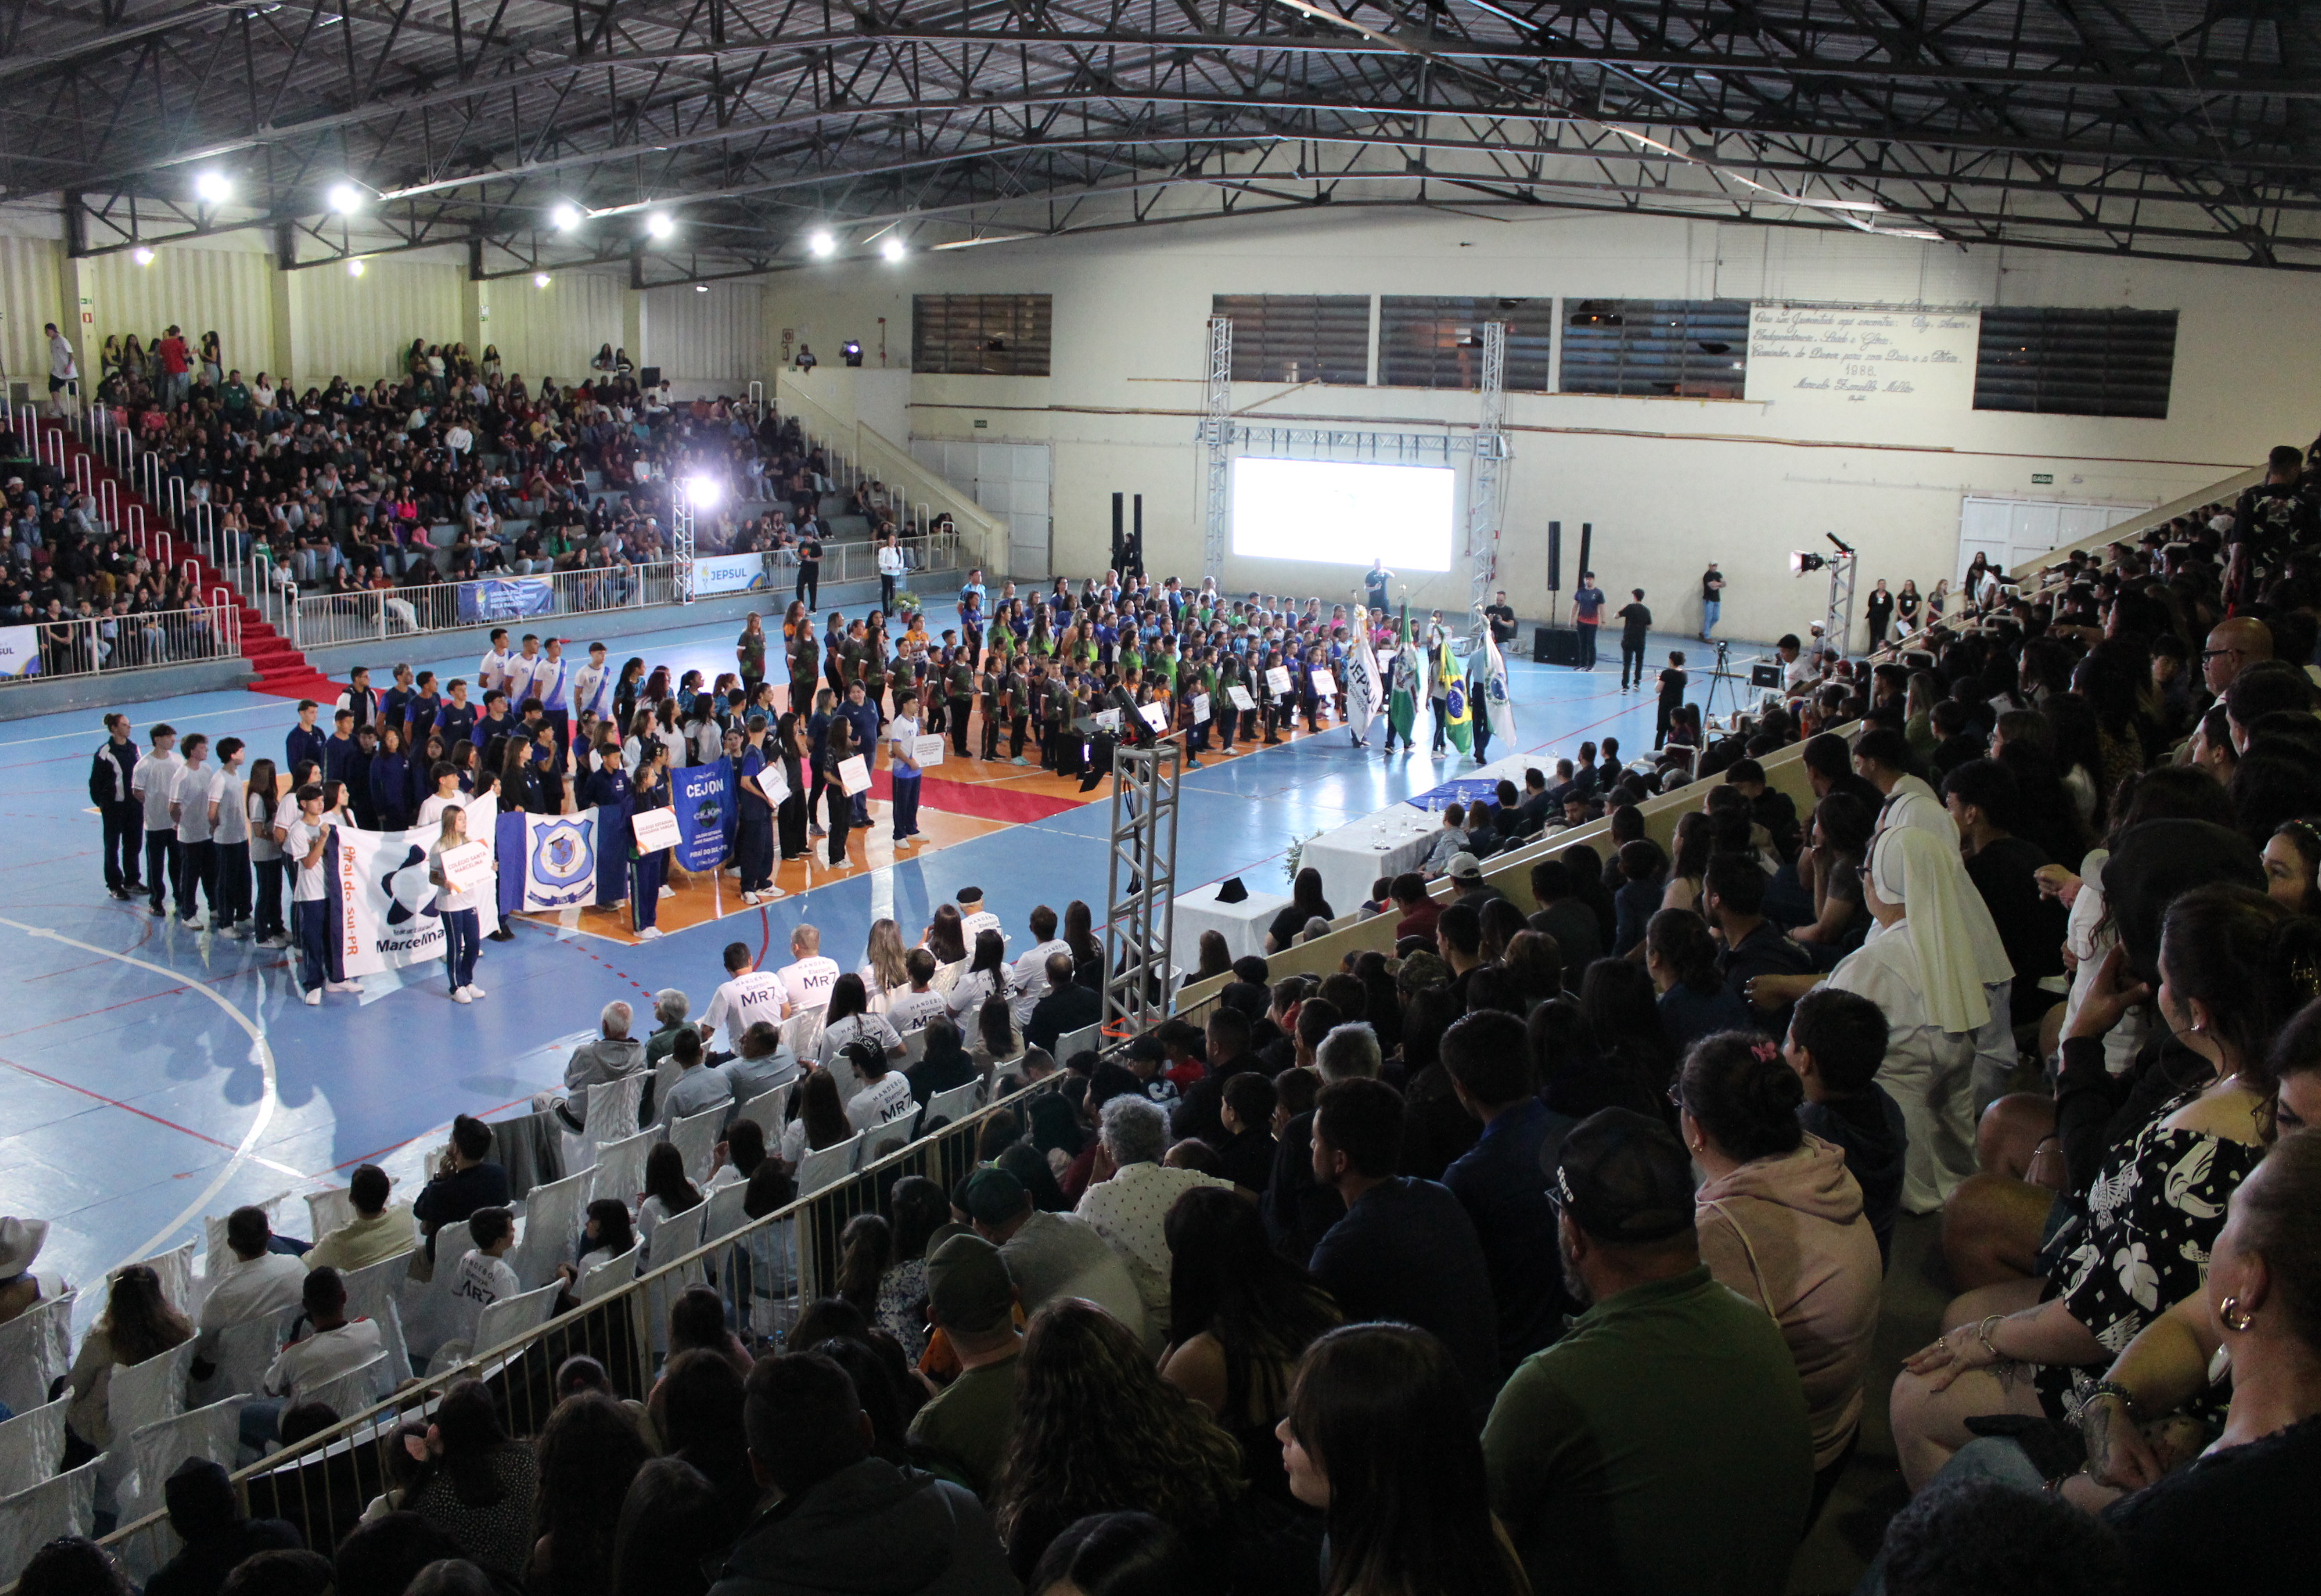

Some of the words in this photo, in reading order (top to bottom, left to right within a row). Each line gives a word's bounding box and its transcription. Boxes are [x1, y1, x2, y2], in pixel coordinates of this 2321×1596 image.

[711, 567, 747, 581] JEPSUL
[376, 928, 445, 954] Marcelina
[909, 998, 942, 1011] HANDEBO
